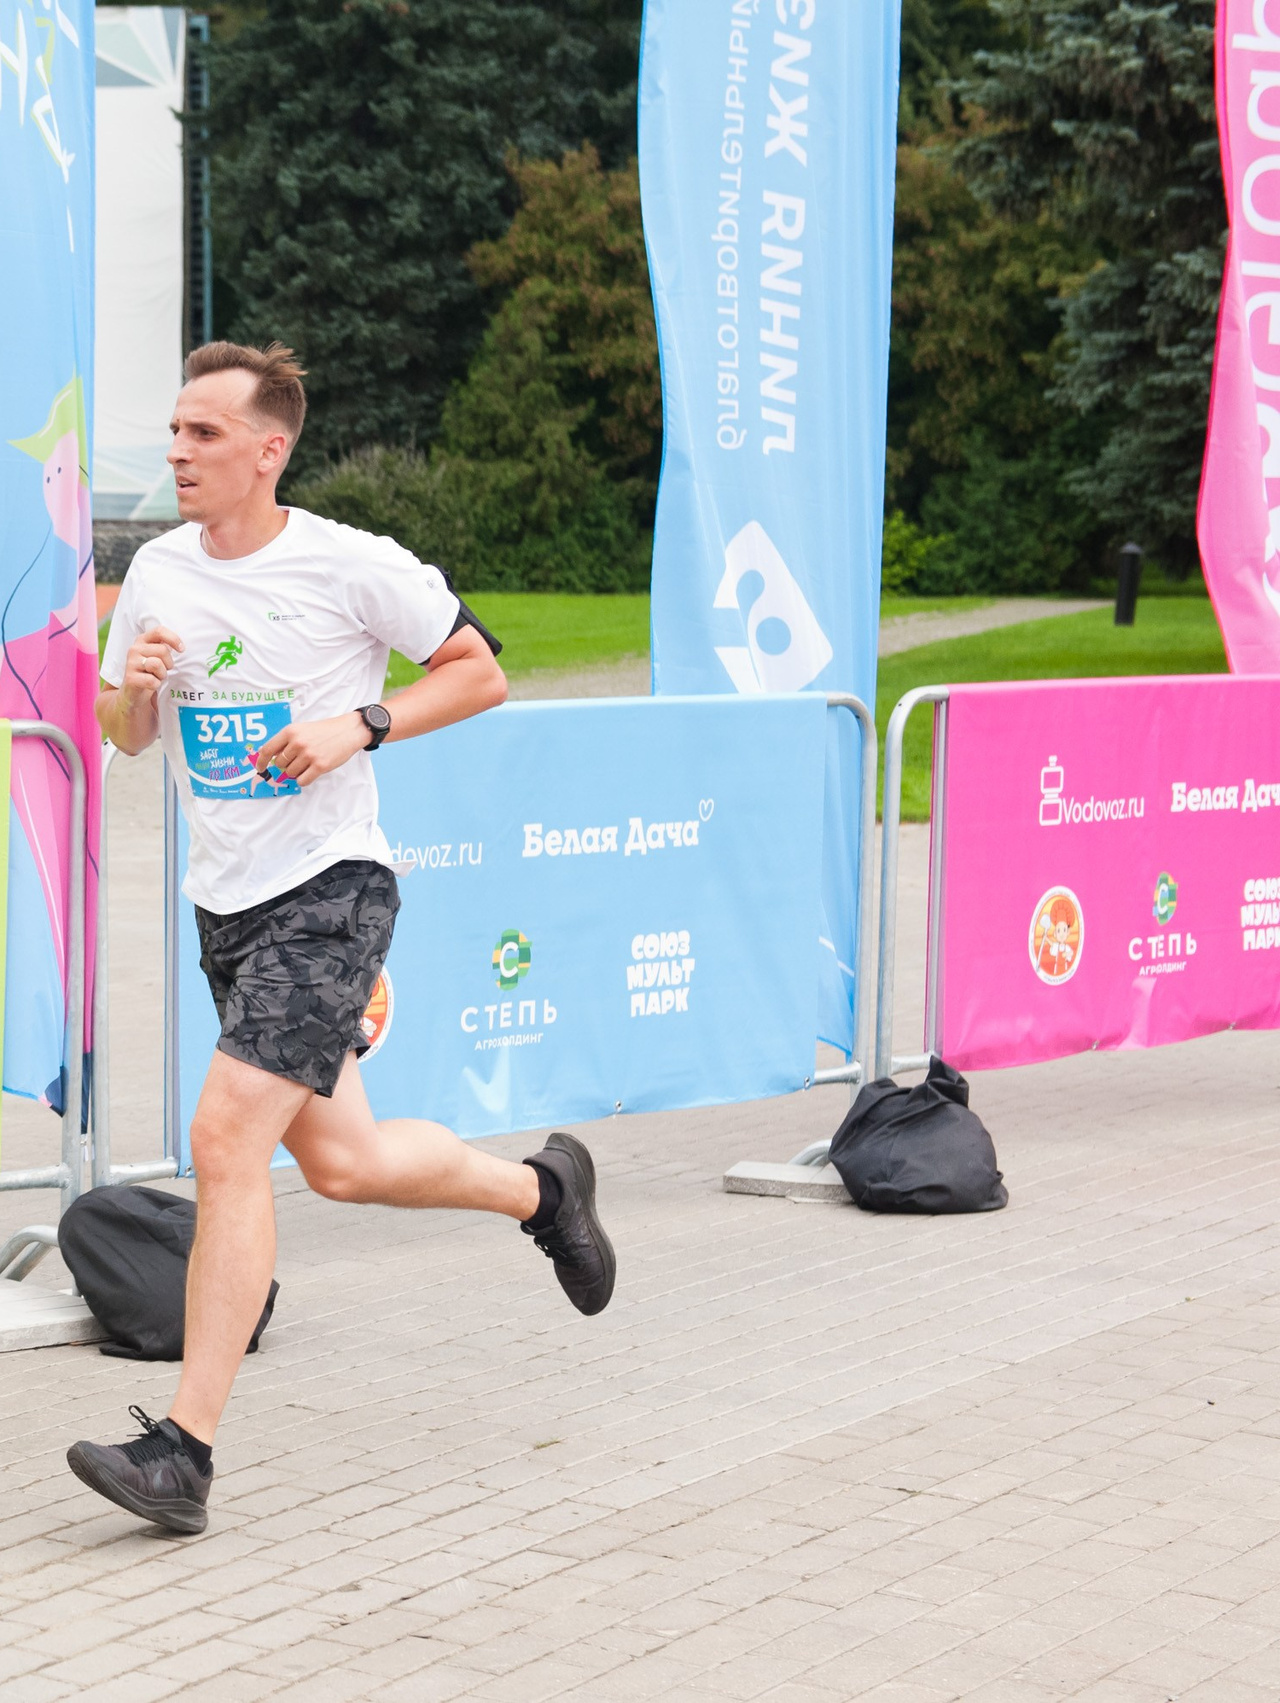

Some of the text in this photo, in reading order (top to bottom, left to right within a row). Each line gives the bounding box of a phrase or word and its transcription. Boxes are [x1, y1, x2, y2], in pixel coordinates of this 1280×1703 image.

[170, 689, 295, 702] ЗАБЕГ ЗА БУДУЩЕЕ
[195, 712, 267, 743] 3215
[1062, 796, 1145, 824] Vodovoz.ru
[1170, 782, 1239, 813] Белая
[522, 817, 700, 857] Белая Дача
[391, 842, 482, 870] dovoz.ru
[1243, 877, 1280, 902] СОЮ
[1240, 901, 1280, 928] МУЛЬ
[631, 930, 690, 960] СОЮЗ
[1128, 932, 1197, 960] СТЕПЬ
[626, 958, 695, 990] МУЛЬТ
[460, 999, 558, 1033] СТЕПЬ
[630, 987, 689, 1017] ПАРК
[474, 1032, 544, 1051] АГРОХОЛДИНГ
